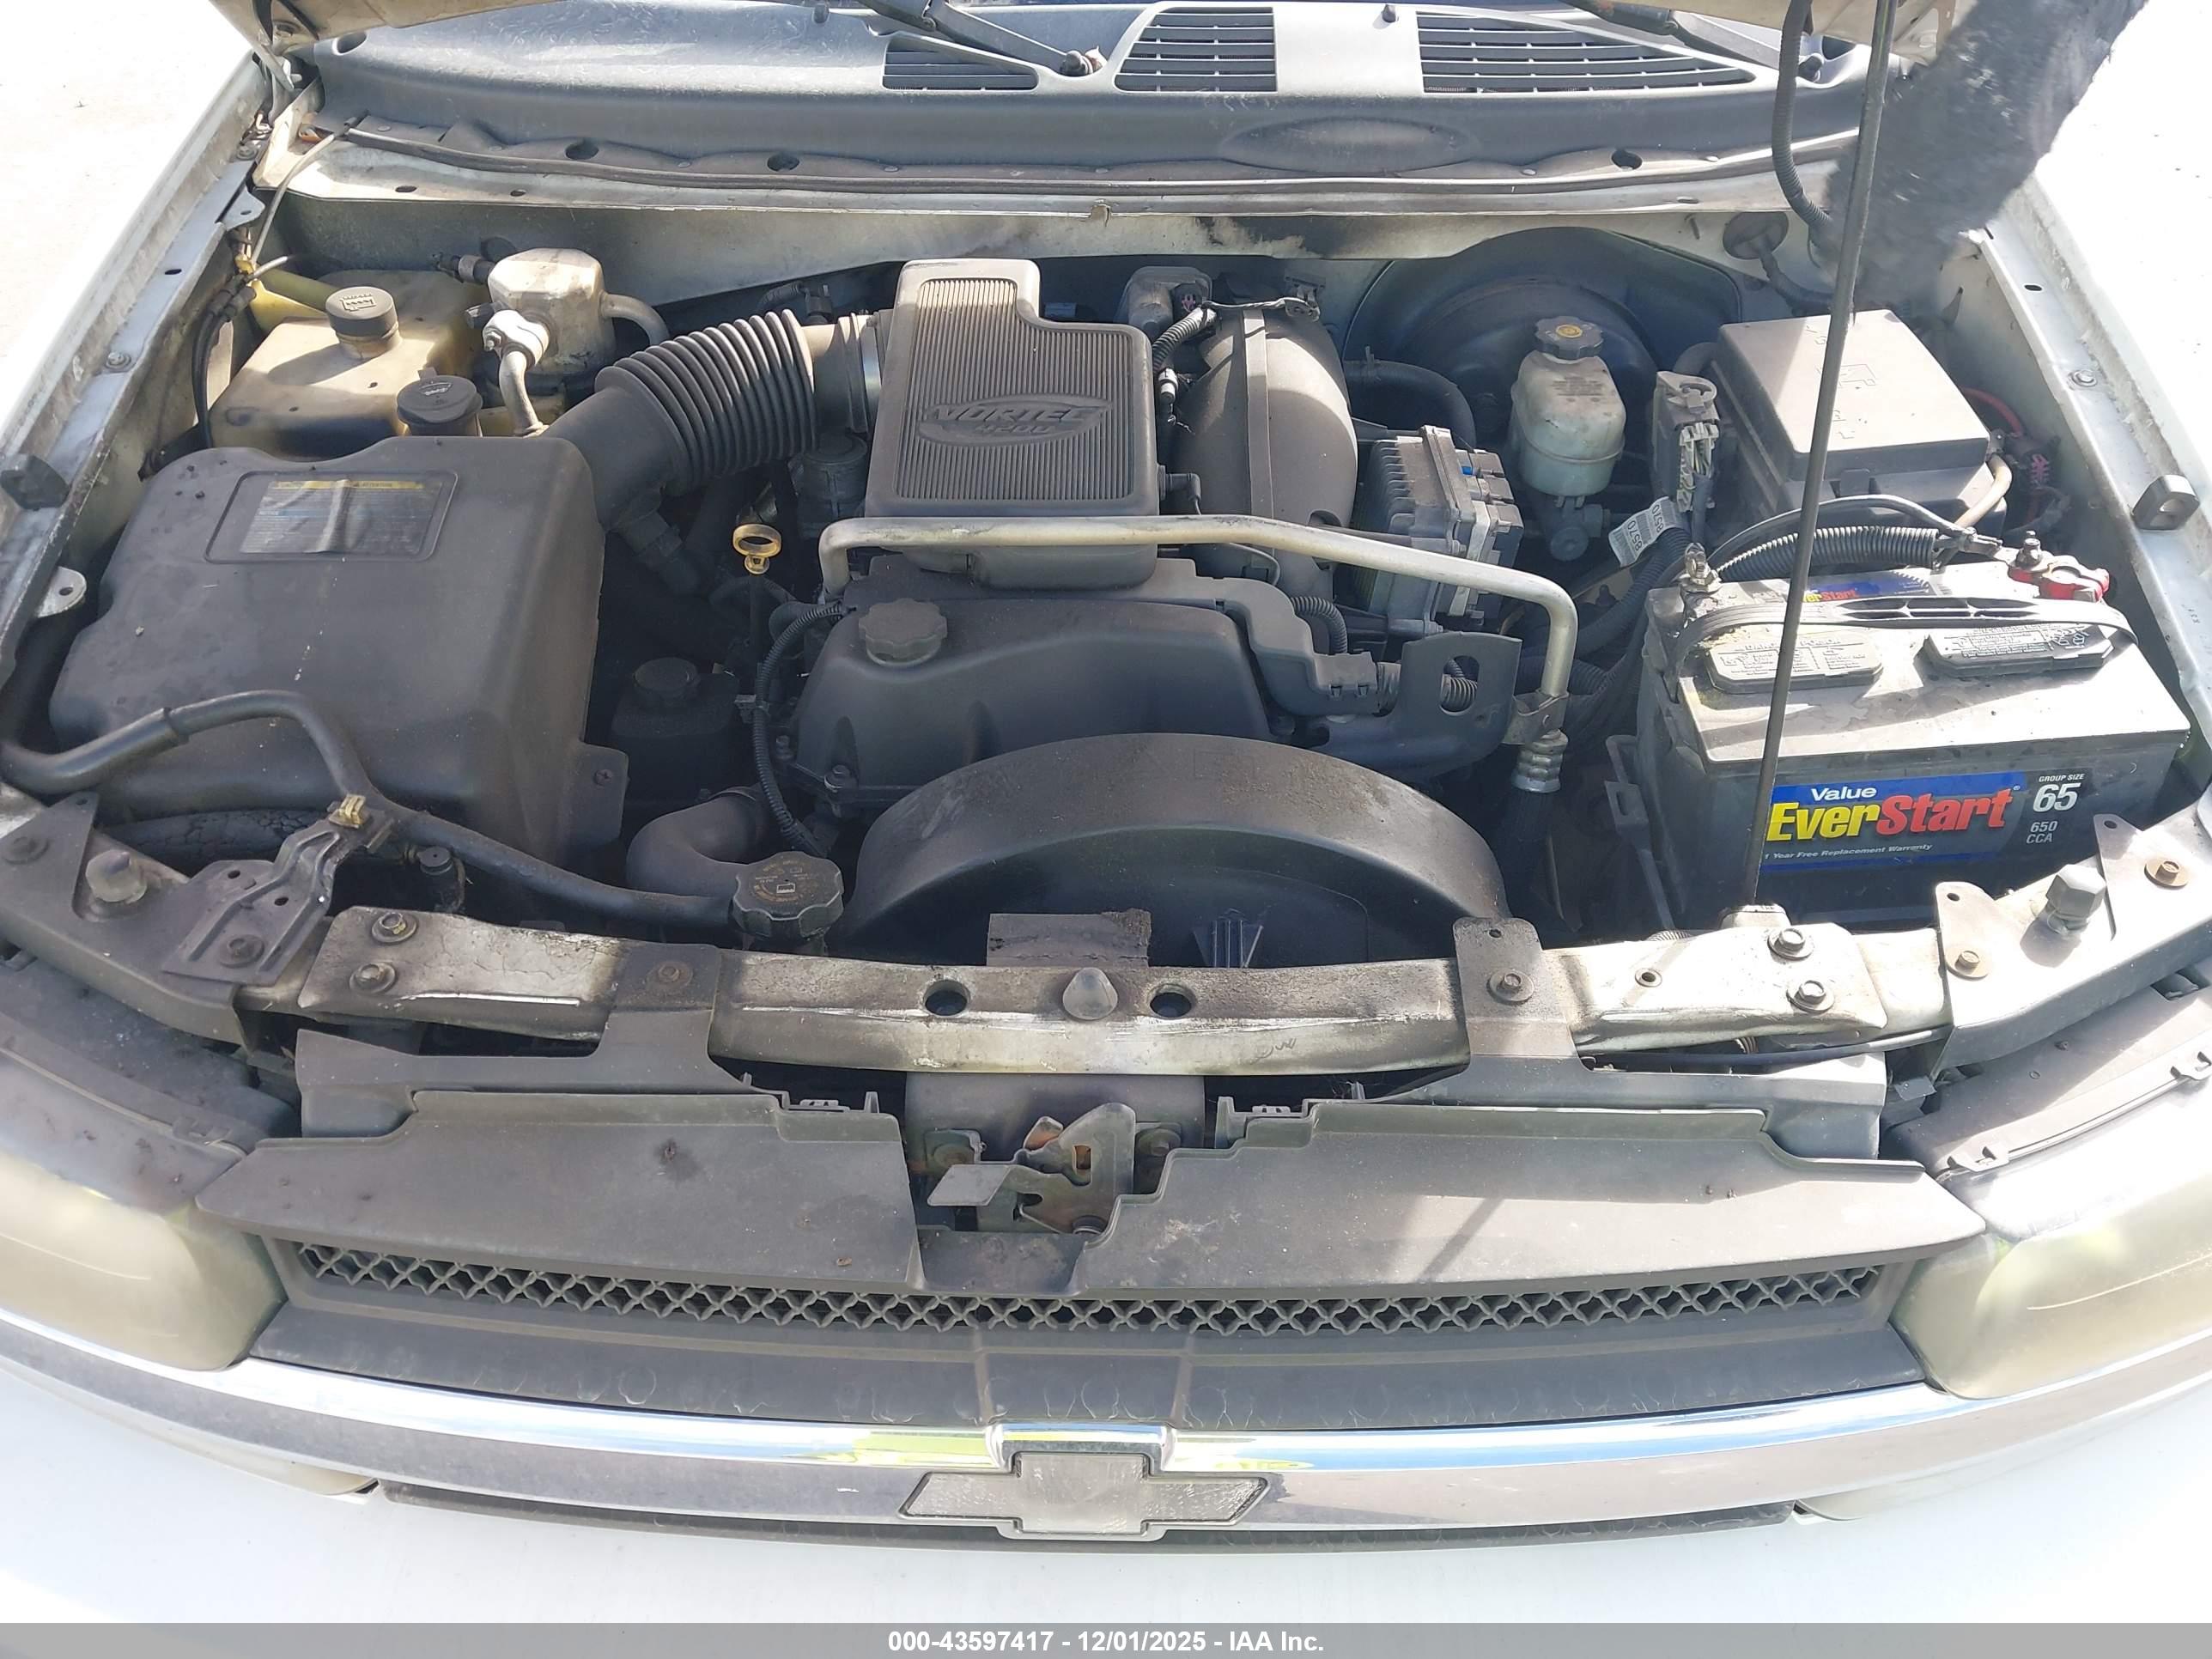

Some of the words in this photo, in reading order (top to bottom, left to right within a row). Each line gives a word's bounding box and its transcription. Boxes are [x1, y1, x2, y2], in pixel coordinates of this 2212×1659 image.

[933, 405, 1102, 422] VORTEC
[1652, 504, 1664, 533] 8570
[1627, 520, 1643, 551] 8570
[2067, 773, 2086, 781] SIZE
[1811, 786, 1878, 801] Value
[2033, 782, 2081, 812] 65
[1766, 787, 2014, 842] EverStart
[2030, 820, 2058, 833] 650
[2026, 833, 2053, 844] CCA
[1821, 846, 1886, 858] Replacement
